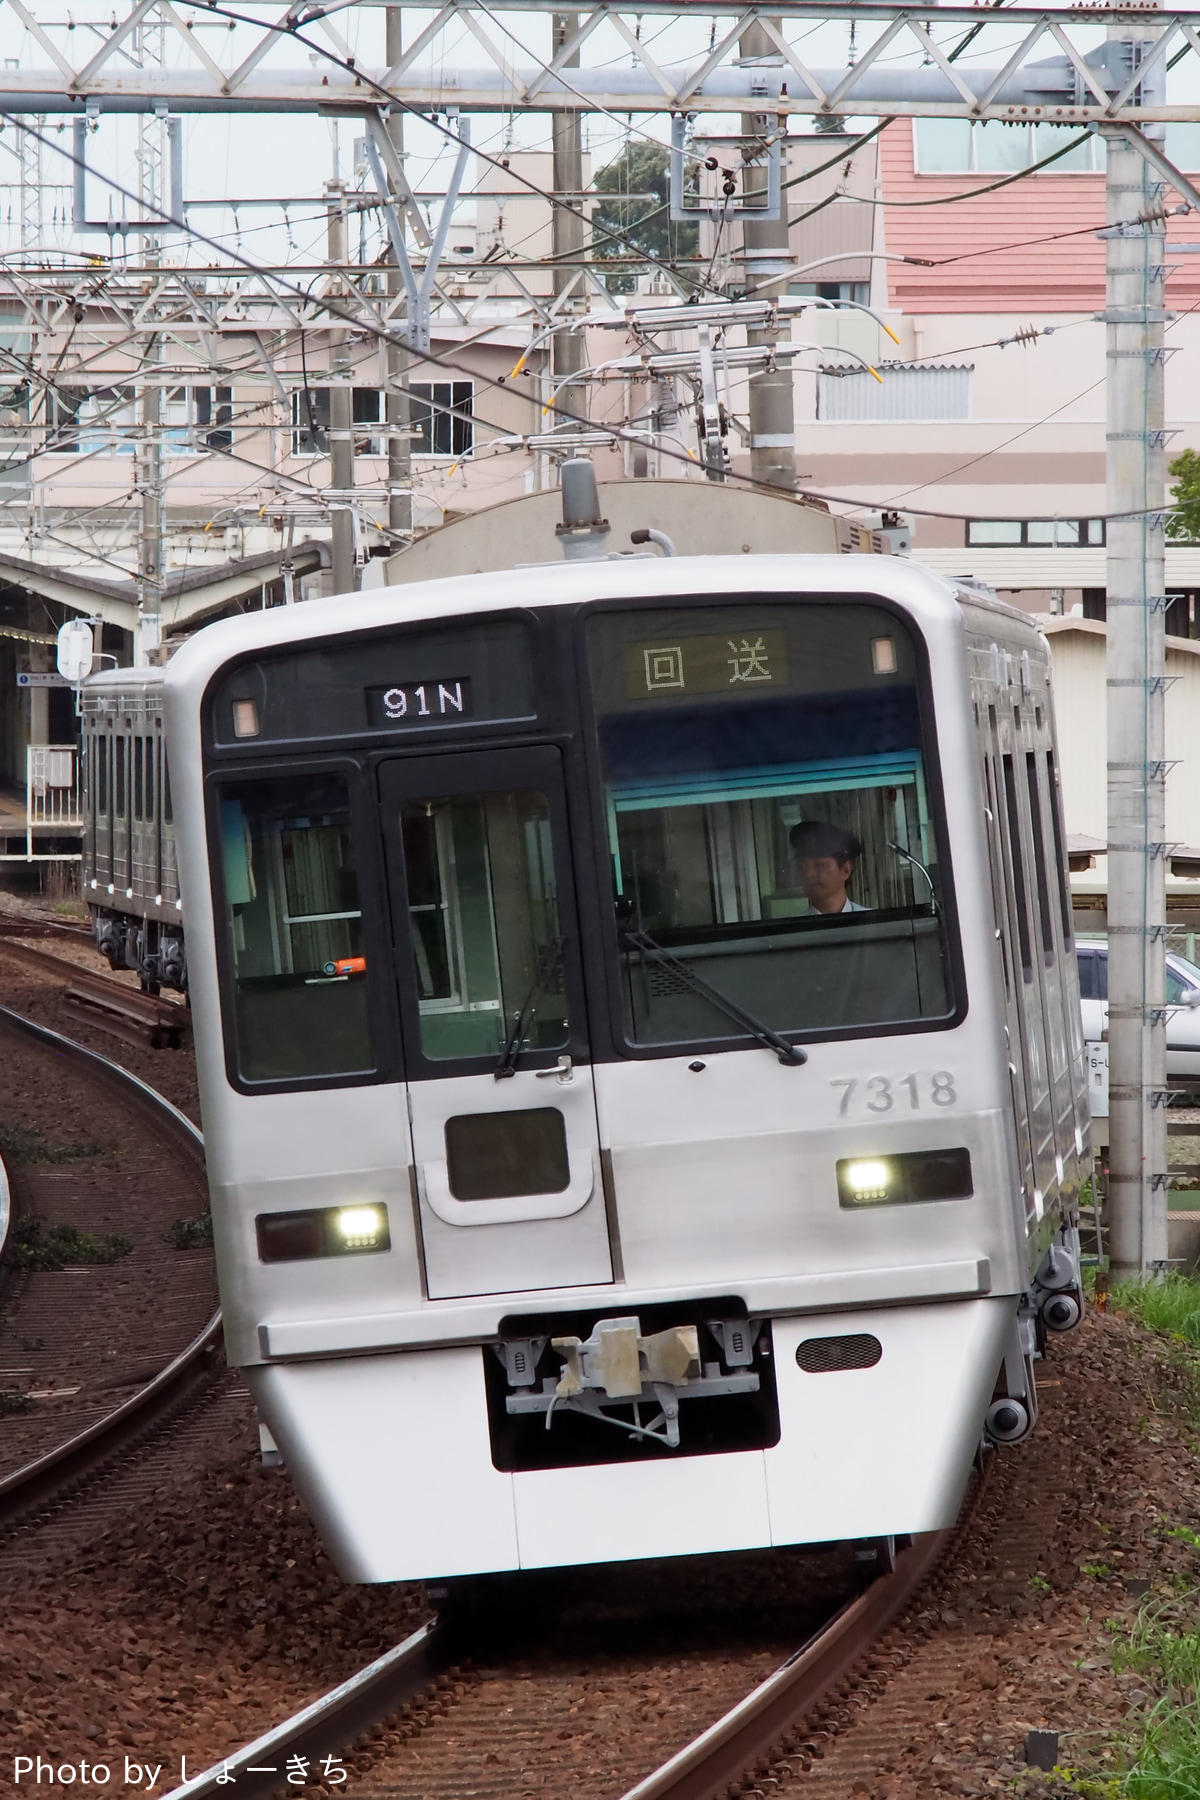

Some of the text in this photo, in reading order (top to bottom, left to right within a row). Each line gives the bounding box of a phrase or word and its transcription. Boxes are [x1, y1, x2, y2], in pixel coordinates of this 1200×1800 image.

[643, 637, 772, 690] 回送
[383, 682, 463, 718] 91N
[830, 1070, 957, 1117] 7318
